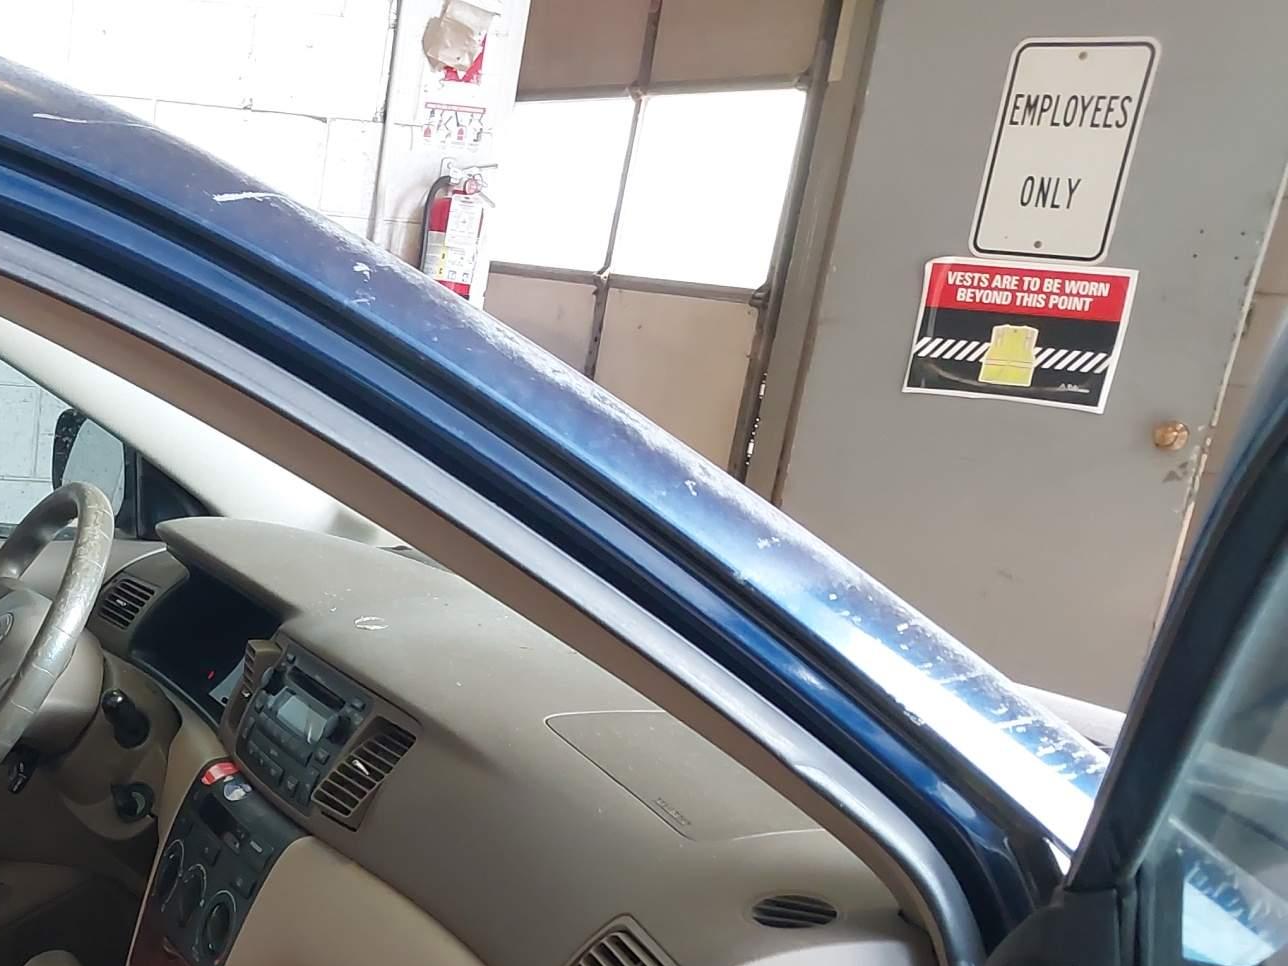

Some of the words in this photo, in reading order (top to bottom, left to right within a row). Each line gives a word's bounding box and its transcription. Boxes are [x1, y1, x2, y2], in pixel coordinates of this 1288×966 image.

[1009, 93, 1132, 128] EMPLOYEES
[1020, 175, 1082, 209] ONLY
[947, 271, 990, 288] VESTS
[991, 274, 1020, 290] ARE
[1022, 276, 1041, 292] TO
[1042, 278, 1063, 293] BE
[1064, 280, 1111, 297] WORN
[956, 287, 1012, 305] BEYOND
[1015, 292, 1047, 308] THIS
[1048, 295, 1094, 311] POINT
